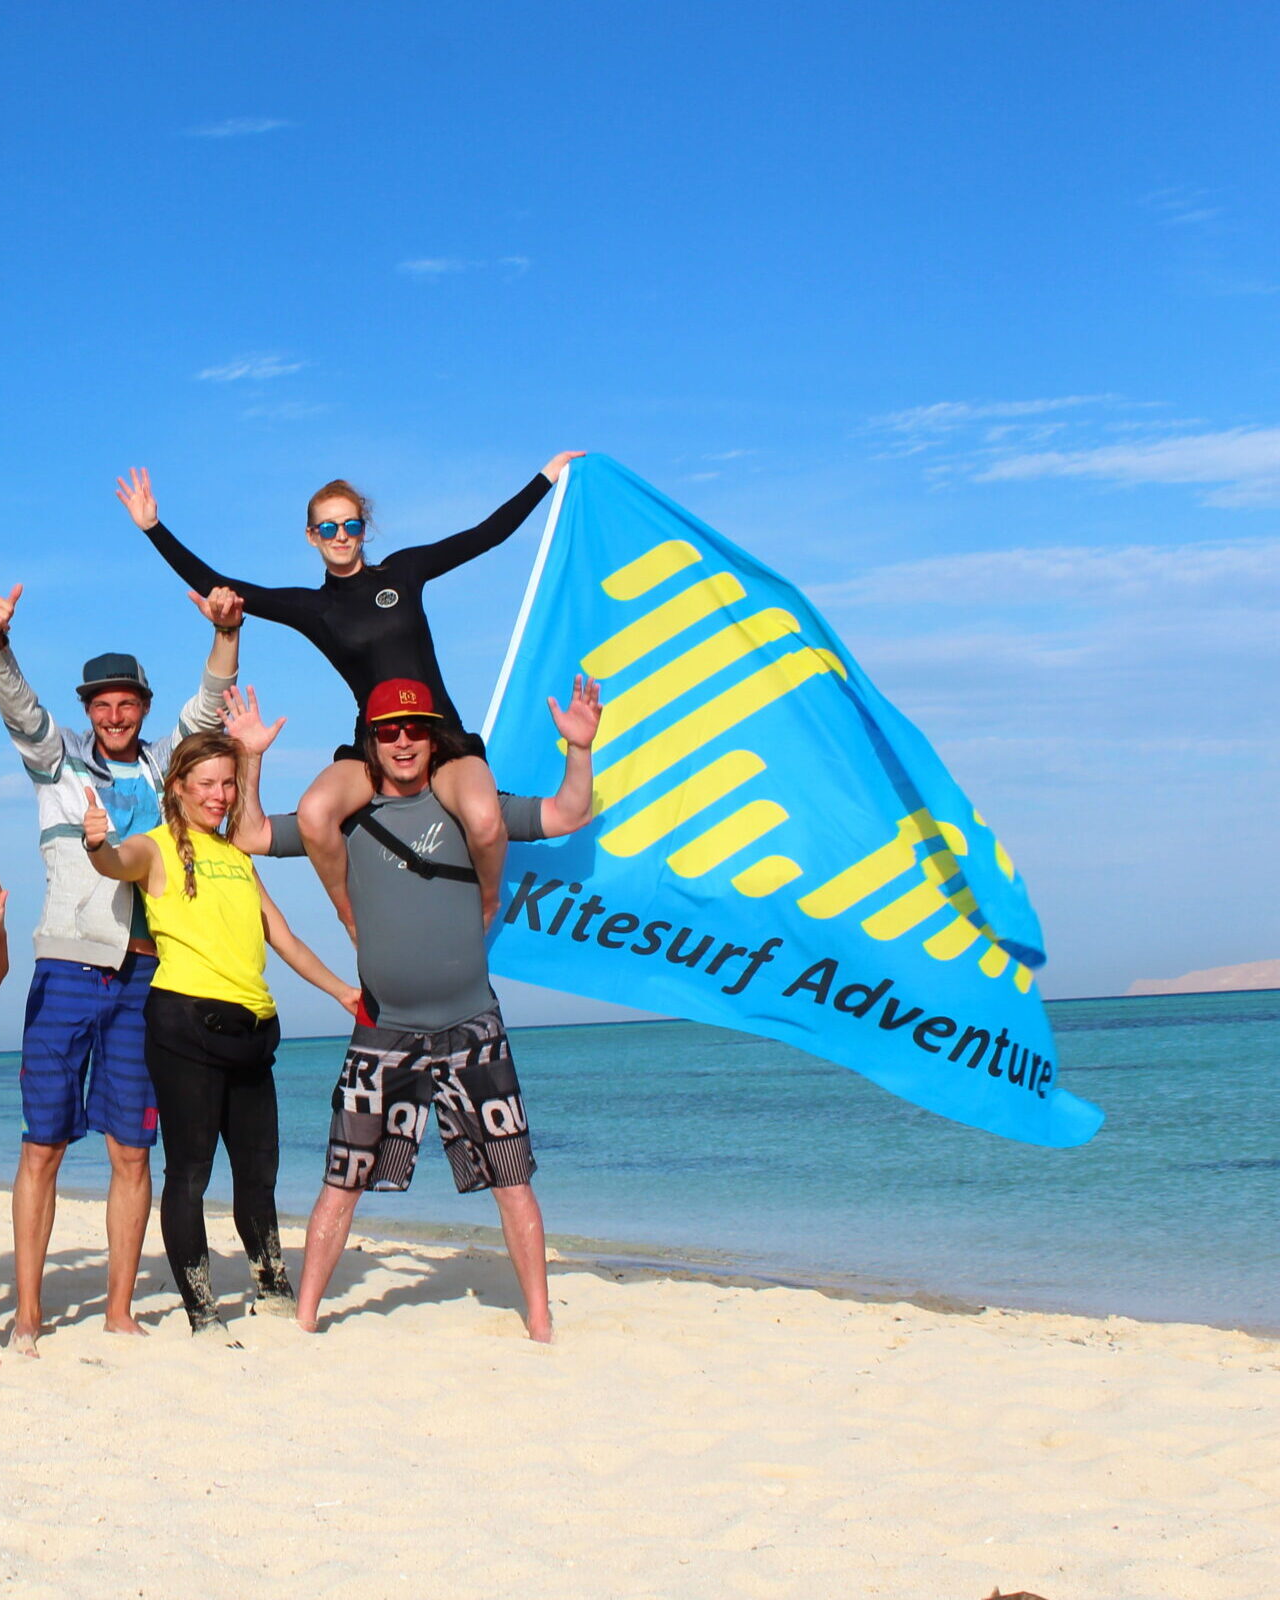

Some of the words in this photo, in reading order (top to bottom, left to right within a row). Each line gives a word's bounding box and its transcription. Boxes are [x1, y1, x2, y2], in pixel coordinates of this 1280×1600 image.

[503, 871, 784, 995] Kitesurf
[782, 957, 1052, 1099] Adventure
[326, 1146, 376, 1188] ER
